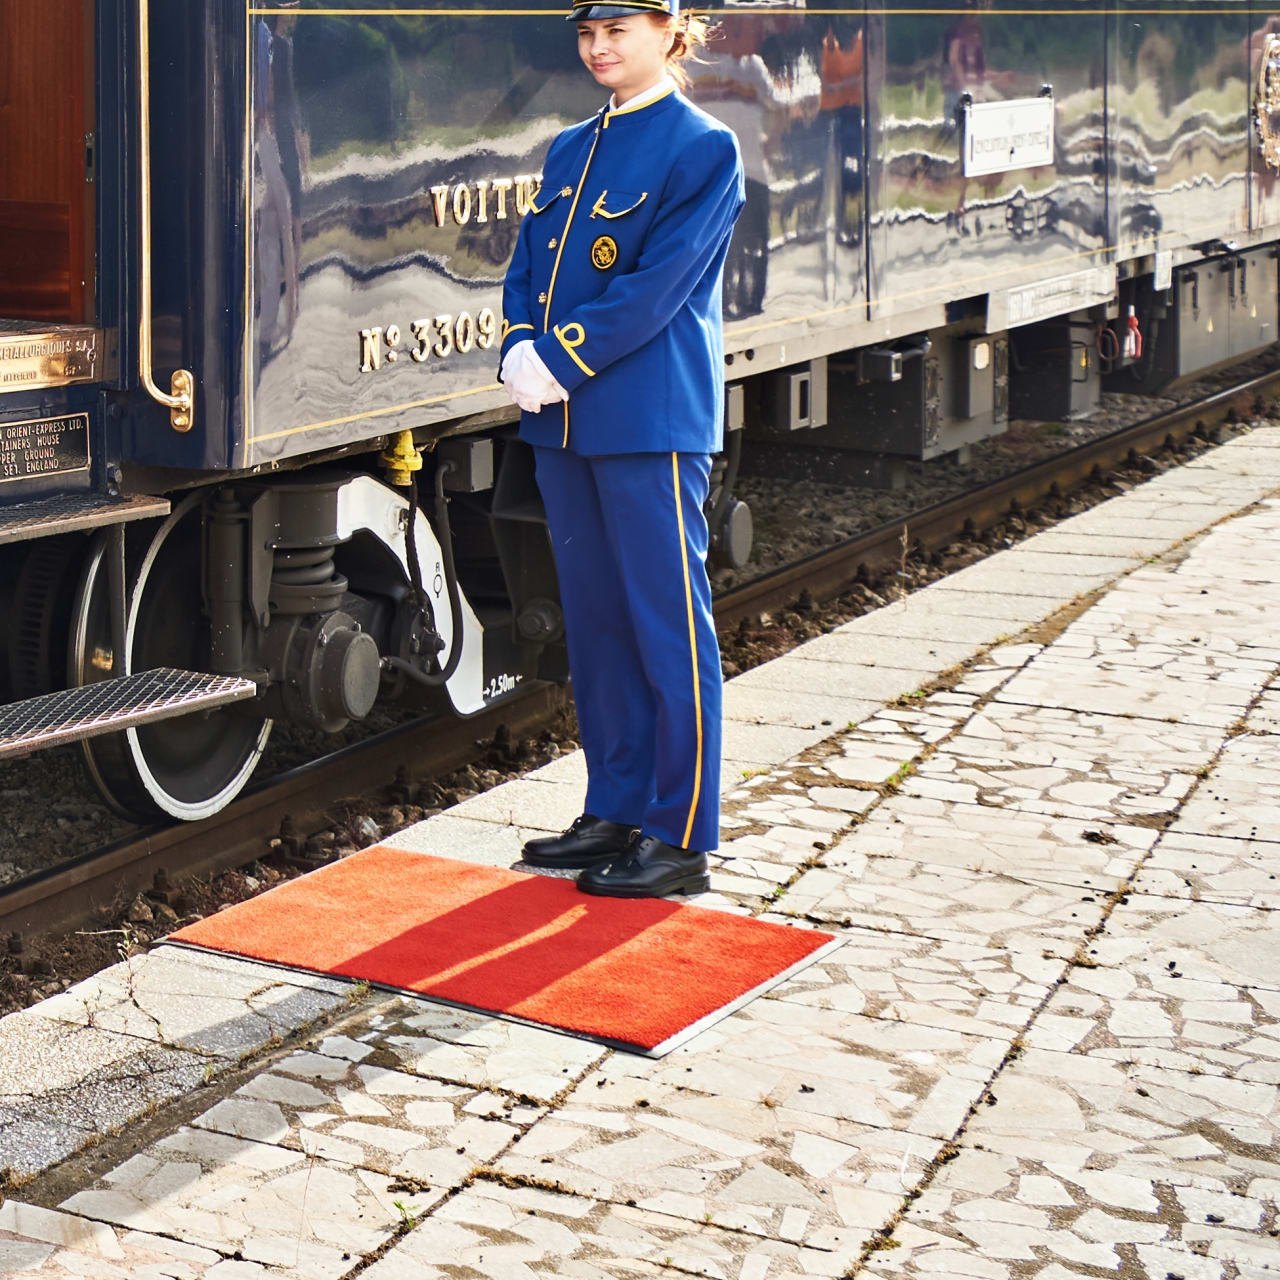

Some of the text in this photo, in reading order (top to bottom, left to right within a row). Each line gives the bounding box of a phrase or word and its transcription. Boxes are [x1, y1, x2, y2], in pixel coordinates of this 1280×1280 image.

[430, 175, 543, 227] VOITU
[410, 307, 496, 363] 3309
[6, 420, 66, 438] ORIENT-EXPRESS
[68, 419, 84, 430] LTD.
[37, 433, 60, 446] HOUSE
[24, 448, 55, 461] GROUND
[490, 673, 515, 697] 2.50m
